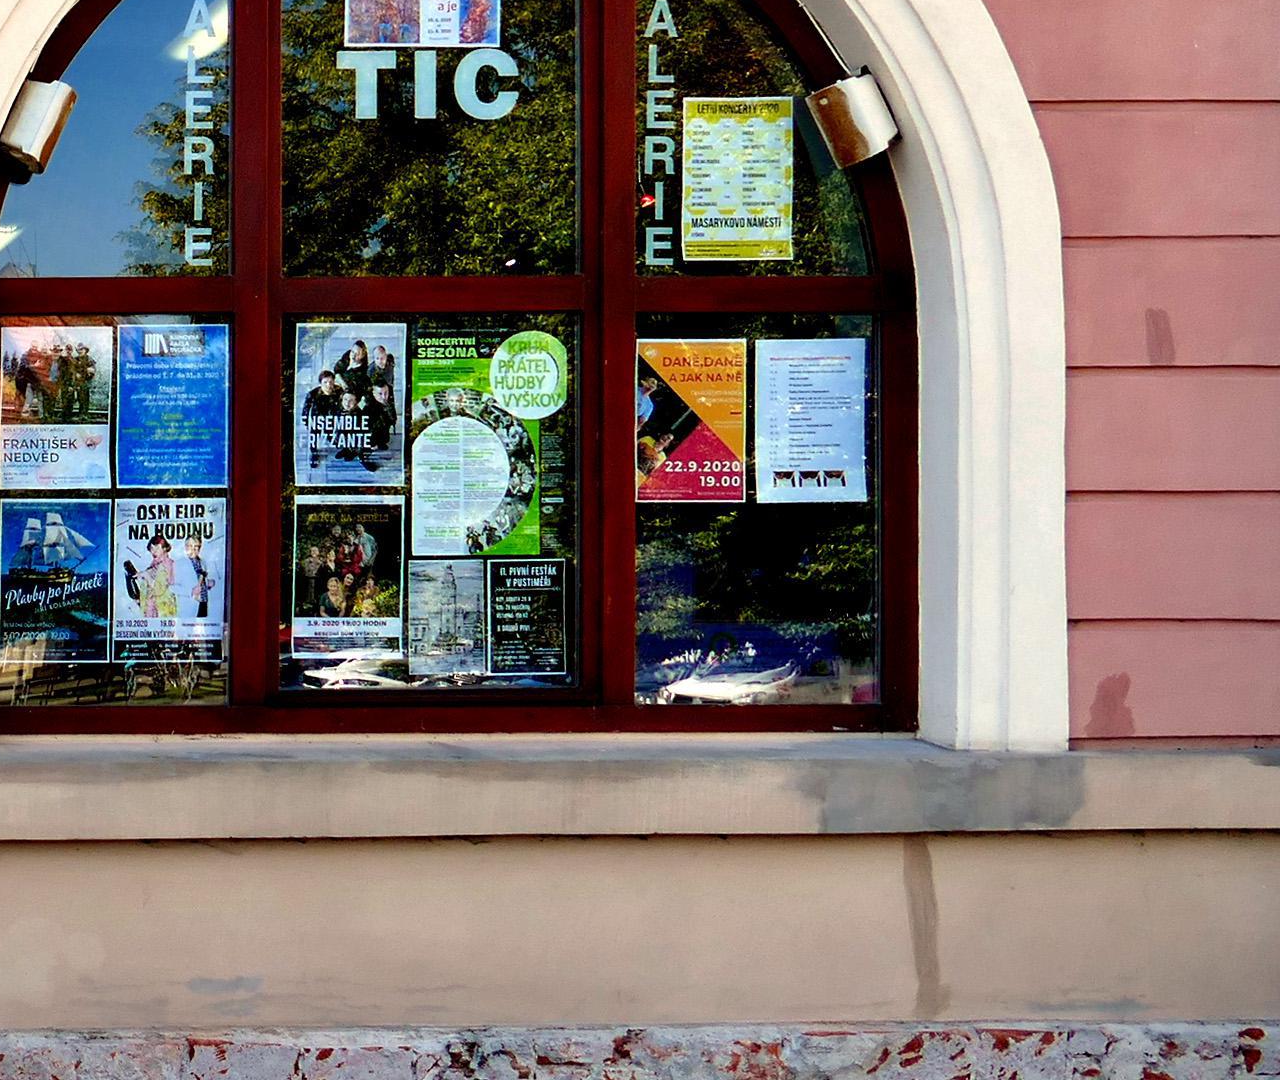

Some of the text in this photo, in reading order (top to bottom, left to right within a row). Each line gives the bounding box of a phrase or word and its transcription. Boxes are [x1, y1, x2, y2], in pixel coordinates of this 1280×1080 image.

[447, 3, 457, 13] je
[336, 48, 520, 120] TIC
[691, 217, 746, 229] MASARYKOVO
[417, 336, 476, 347] KONCERTNÍ
[507, 340, 550, 354] KRUH
[417, 346, 478, 358] SEZÓNA
[498, 357, 549, 373] PŘÁTEL
[494, 375, 546, 390] HUDBY
[668, 371, 743, 382] A JAK NA NĚ
[502, 391, 562, 408] VYŠKOV
[301, 415, 370, 431] ENSEMBLE
[2, 435, 78, 450] FRANTIŠEK
[299, 433, 372, 448] FRIZZANTE
[3, 450, 60, 463] NEDVĚD
[664, 460, 741, 473] 22.9.2020
[699, 476, 741, 487] 19.00
[136, 504, 205, 521] OSM EUR
[128, 522, 214, 541] NA HODINU
[5, 572, 104, 610] Plavby po planetě
